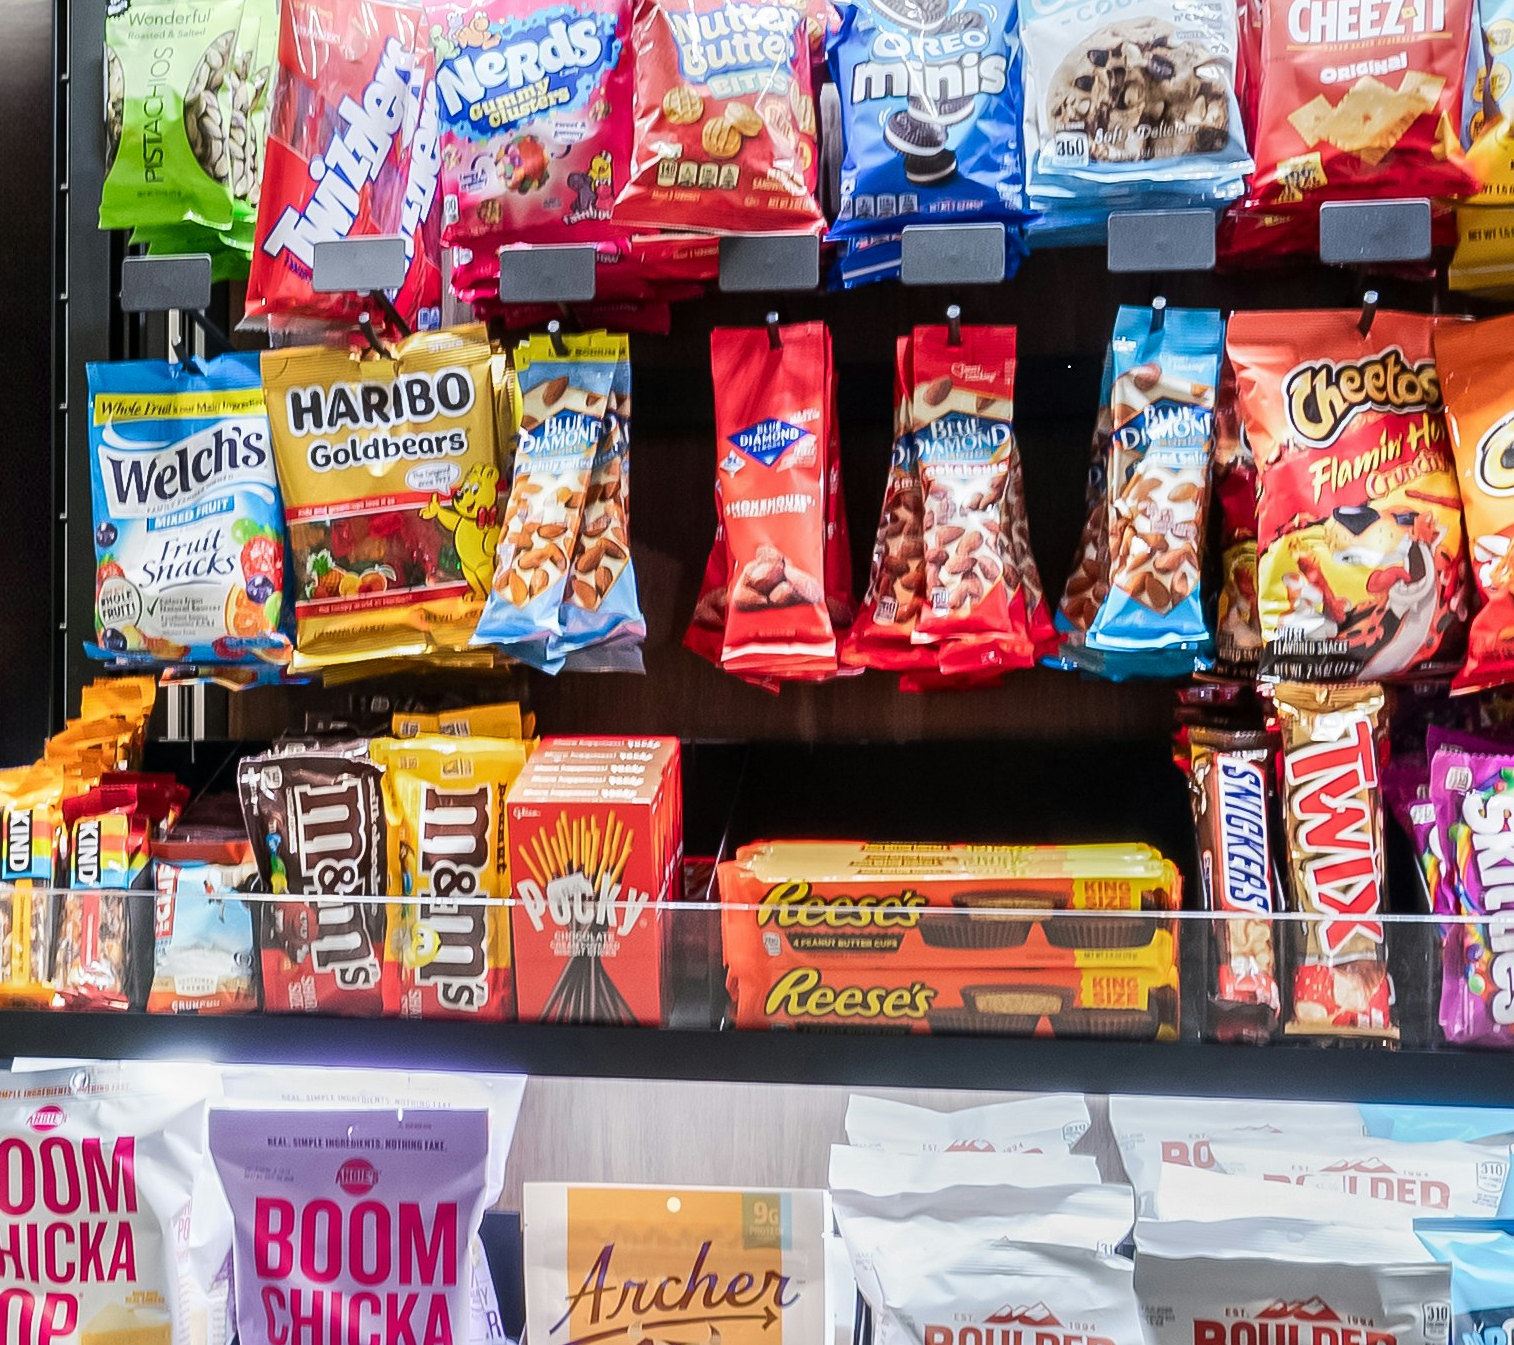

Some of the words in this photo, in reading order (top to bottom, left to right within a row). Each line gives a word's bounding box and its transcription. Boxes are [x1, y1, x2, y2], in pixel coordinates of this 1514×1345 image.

[128, 8, 211, 28] Wonderful
[673, 0, 799, 51] Nutter
[873, 25, 988, 60] OREO
[708, 69, 790, 95] BITES
[852, 53, 1008, 105] minis
[145, 46, 174, 184] PISTACHIOS
[291, 370, 473, 432] HARIBO
[1287, 346, 1440, 442] Cheetos
[310, 430, 466, 469] Goldbears
[740, 428, 802, 444] DIAMOND
[914, 423, 1012, 458] DIAMOND
[931, 418, 977, 439] BLUE
[107, 426, 267, 504] Welch's
[155, 512, 190, 529] MIXED
[192, 498, 230, 522] FRUIT
[159, 529, 227, 558] Fruit
[142, 551, 236, 587] Snacks
[7, 810, 31, 873] KIND
[76, 820, 97, 885] KIND
[1223, 762, 1268, 912] SNICKERS
[1288, 719, 1382, 956] TWIX
[757, 880, 926, 929] Reese's
[1083, 880, 1132, 894] KING
[1091, 894, 1132, 909] SIZE
[765, 968, 937, 1019] Reese's
[1092, 976, 1139, 991] KING
[1094, 992, 1138, 1008] SIZE
[254, 1196, 459, 1287] BOOM
[549, 1240, 800, 1337] Archer
